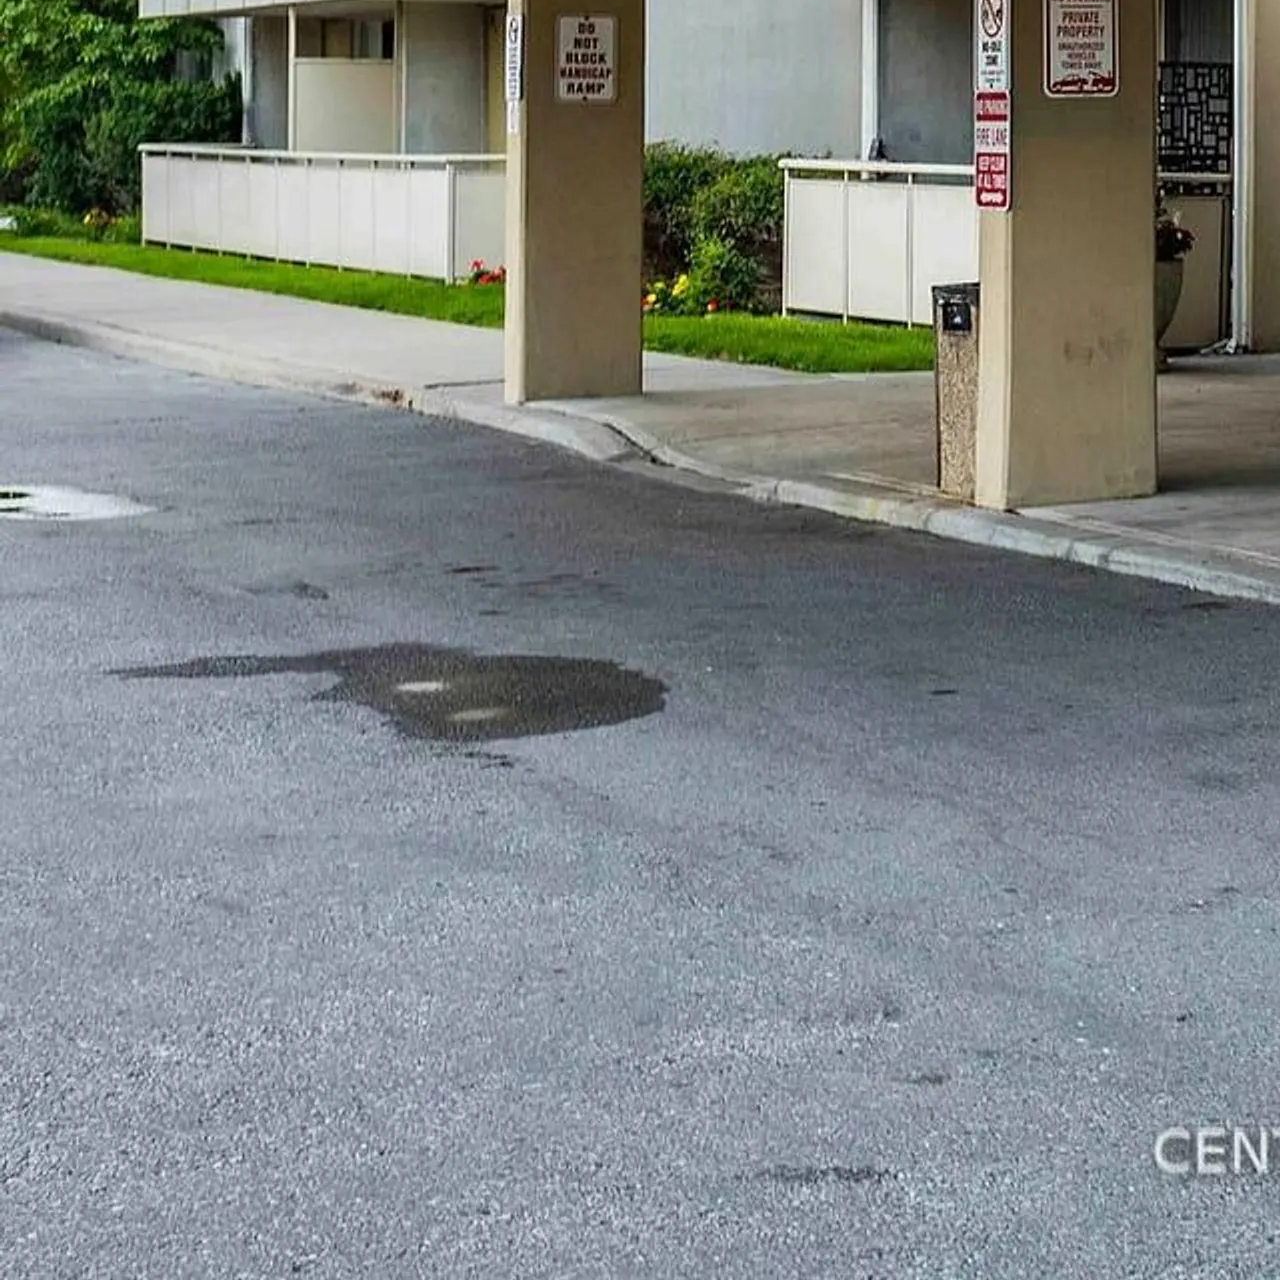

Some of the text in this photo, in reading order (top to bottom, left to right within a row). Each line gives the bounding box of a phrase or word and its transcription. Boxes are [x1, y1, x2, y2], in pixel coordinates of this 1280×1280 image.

[1062, 11, 1099, 24] PRIVATE
[578, 22, 596, 35] DO
[1056, 25, 1105, 38] PROPERTY
[573, 37, 599, 49] NOT
[566, 52, 607, 64] BLOCK
[560, 68, 612, 80] HANDICAP
[566, 83, 606, 95] RAMP
